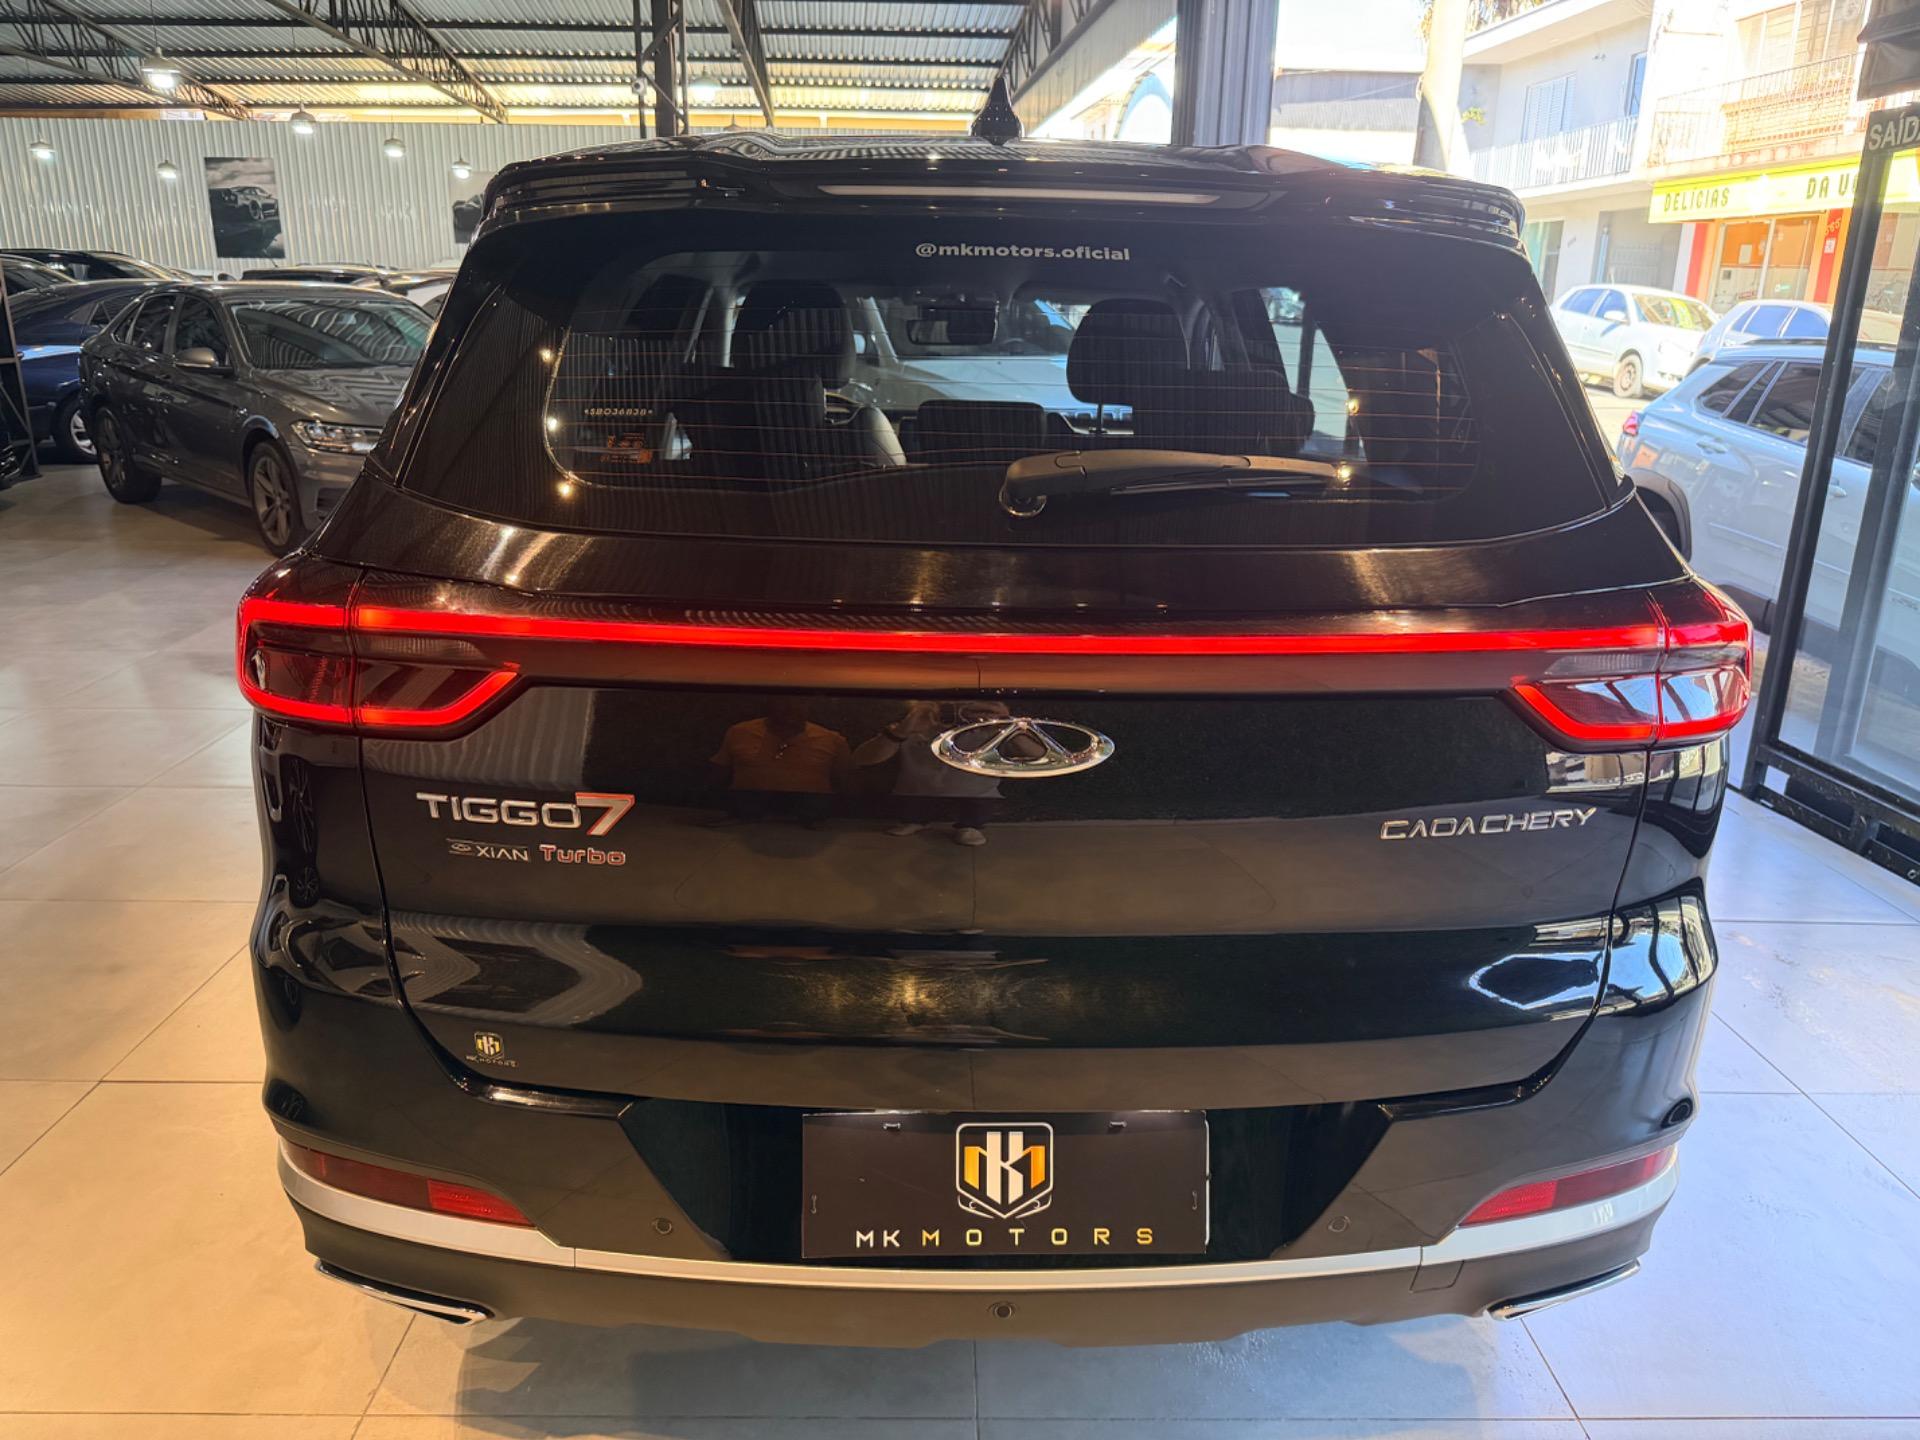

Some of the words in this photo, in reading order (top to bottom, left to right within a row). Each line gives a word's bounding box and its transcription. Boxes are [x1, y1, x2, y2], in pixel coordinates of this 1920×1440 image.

[1806, 175, 1829, 199] DA
[915, 242, 1130, 261] @mkmotors.oficial
[539, 843, 626, 866] Turbo
[855, 1229, 900, 1249] MK
[921, 1227, 1154, 1248] MOTORS
